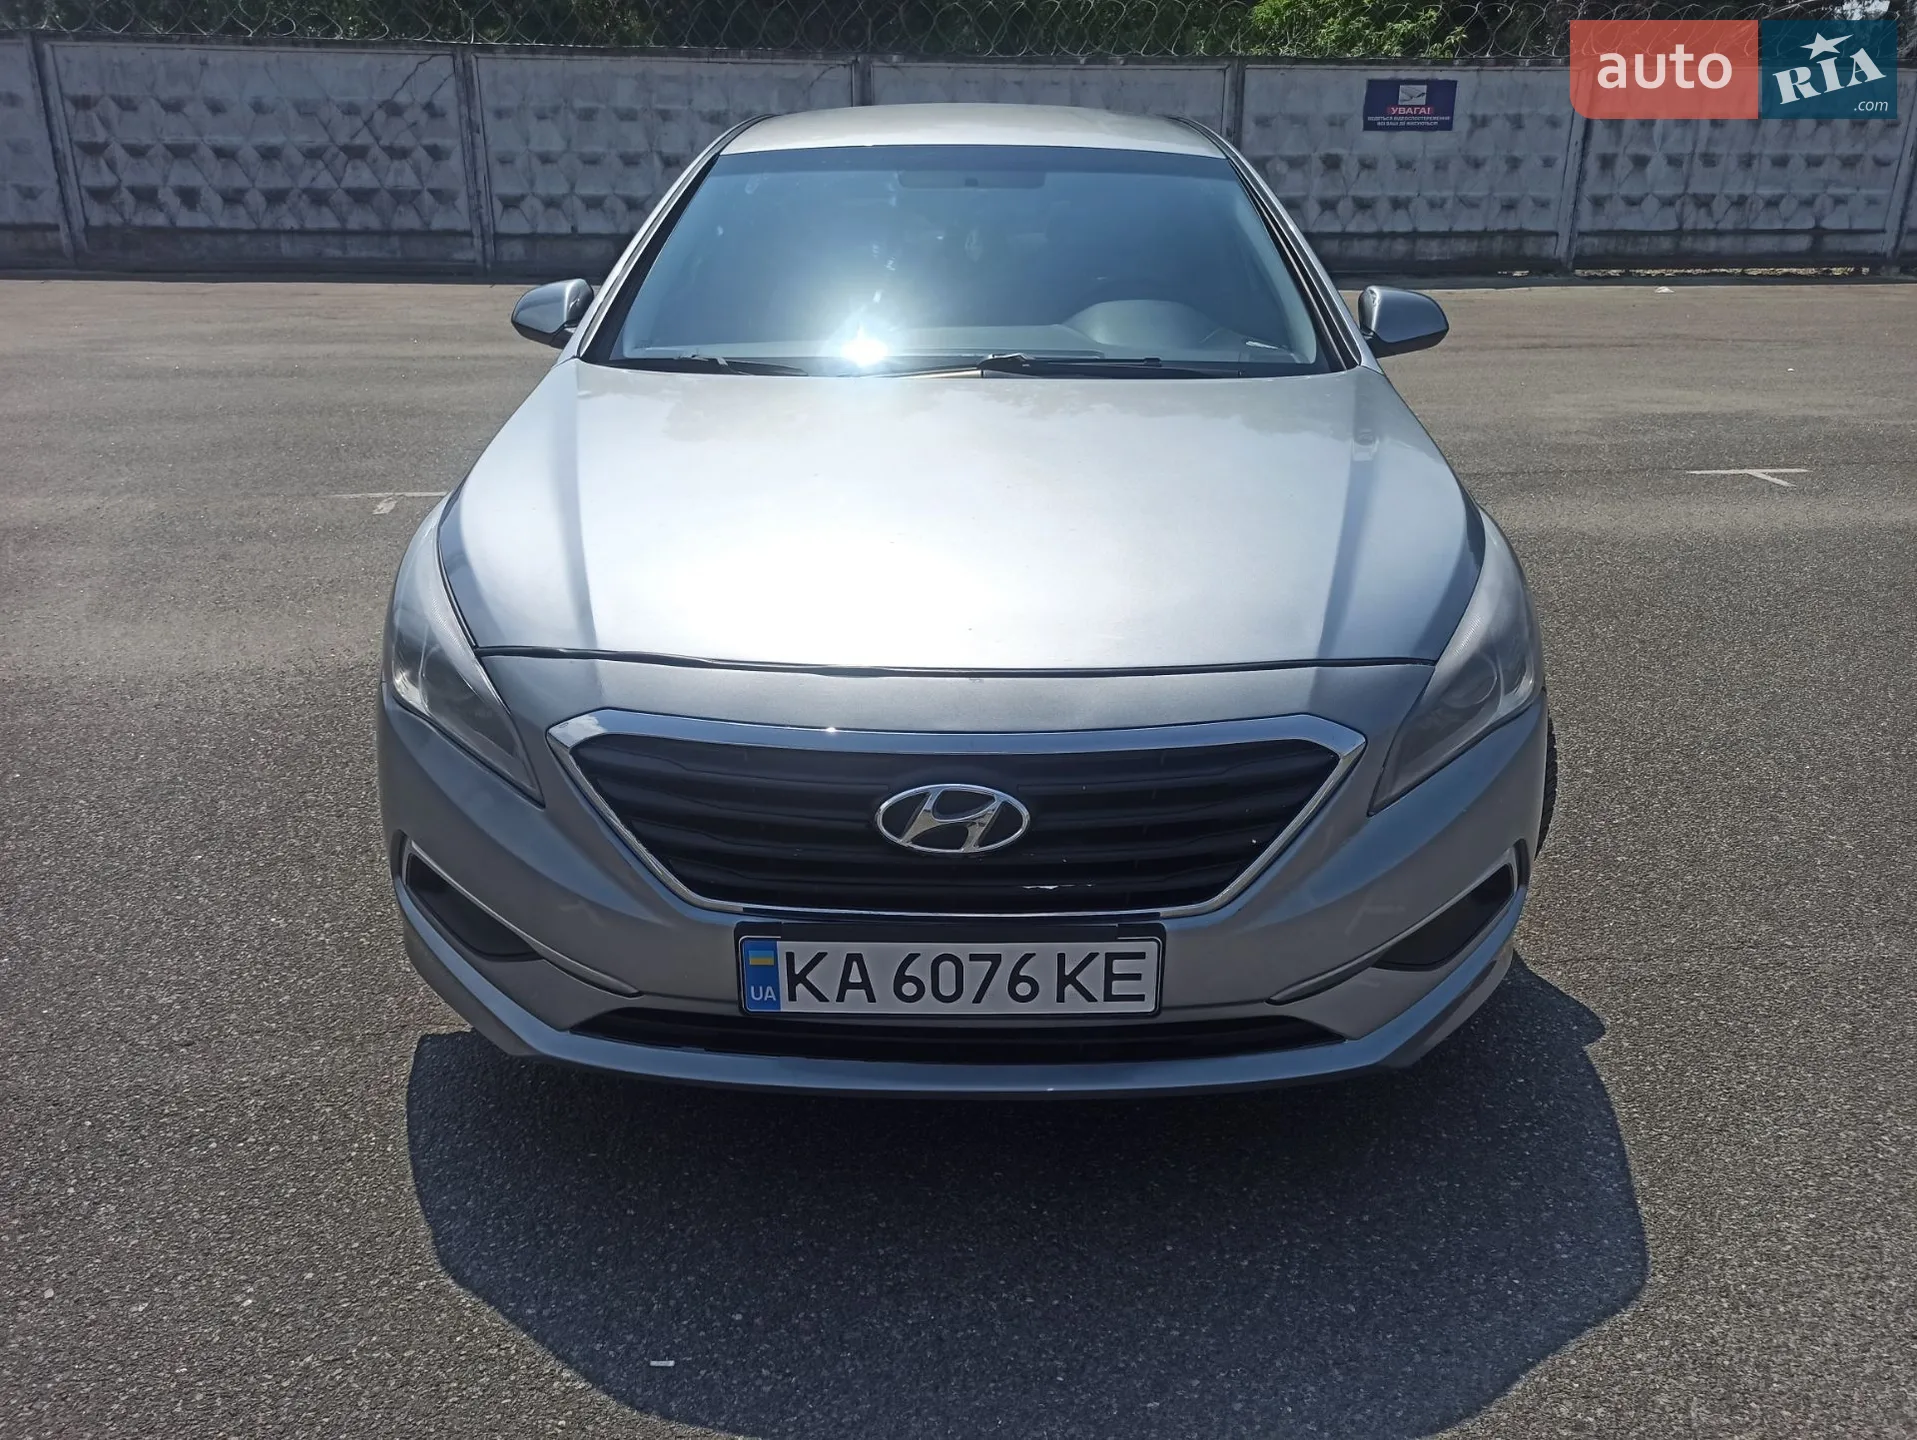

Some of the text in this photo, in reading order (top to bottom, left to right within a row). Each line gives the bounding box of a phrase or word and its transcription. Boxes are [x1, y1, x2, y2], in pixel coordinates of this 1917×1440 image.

[1391, 107, 1430, 115] УВАГА!
[786, 952, 1146, 1004] KA 6076 KE
[750, 985, 777, 1001] UA
